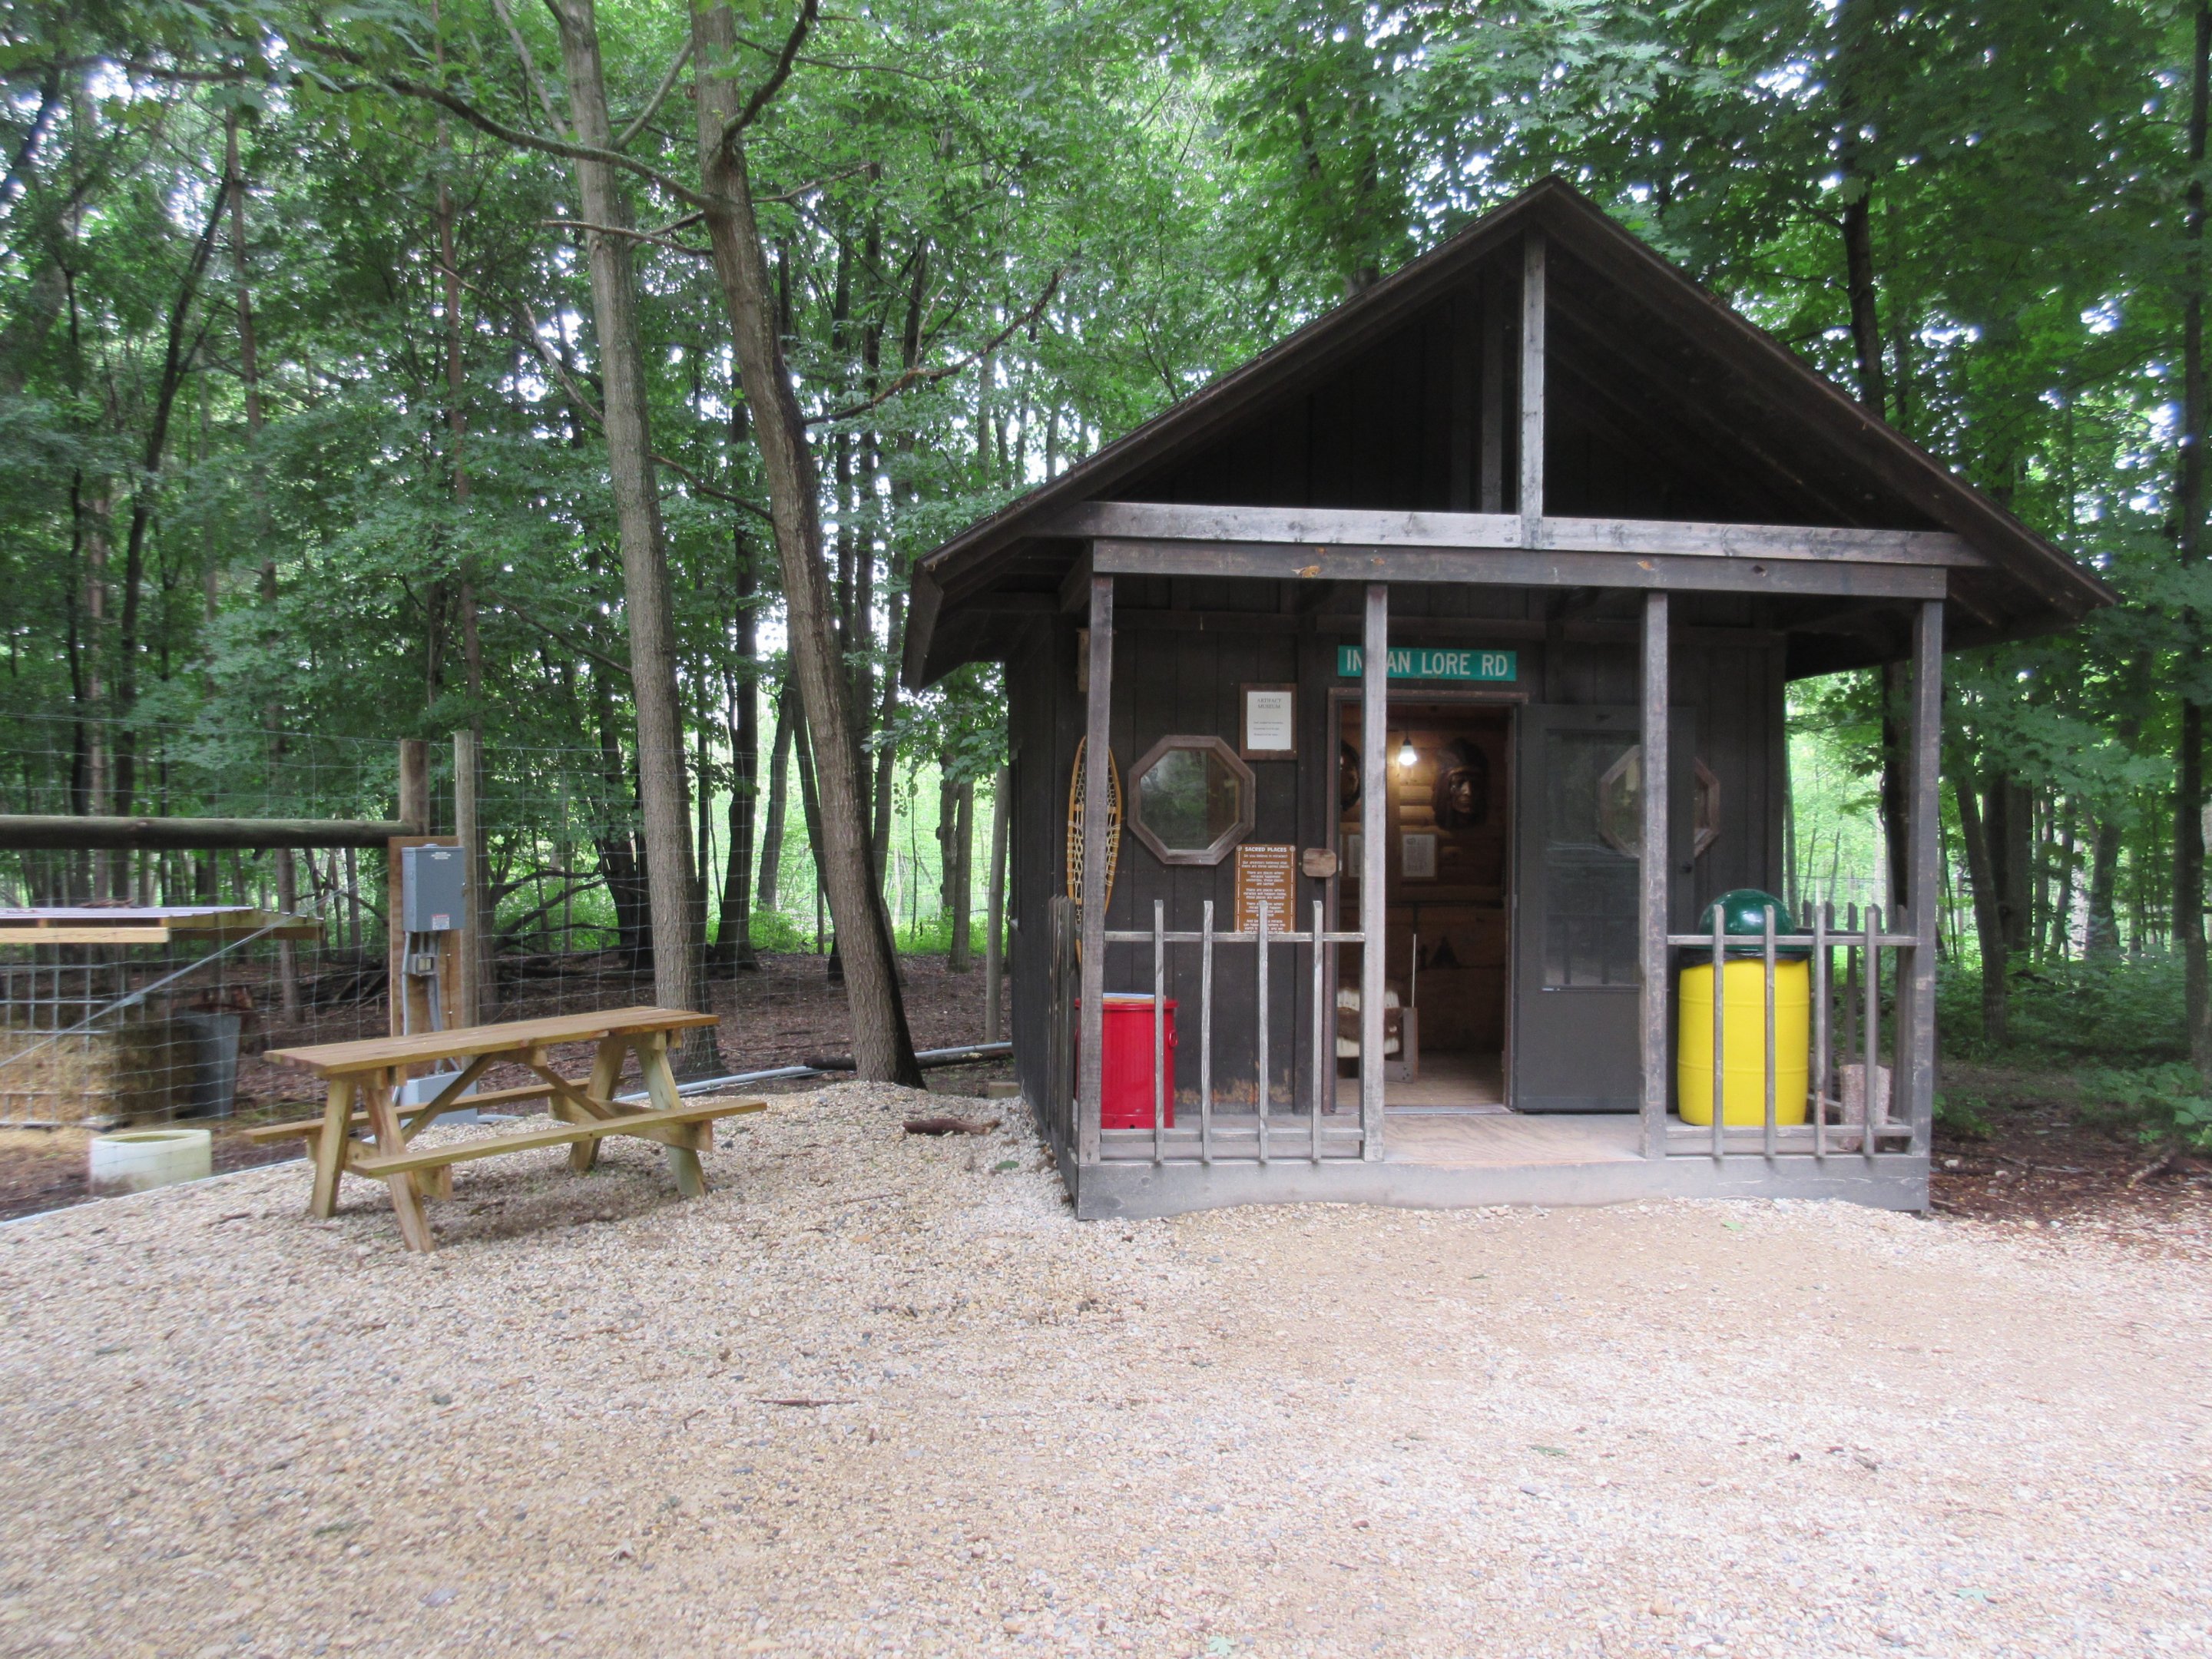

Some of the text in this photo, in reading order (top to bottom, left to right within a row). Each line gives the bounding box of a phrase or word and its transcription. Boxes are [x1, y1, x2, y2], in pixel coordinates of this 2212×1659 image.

[1346, 649, 1508, 676] INAN LORE RD
